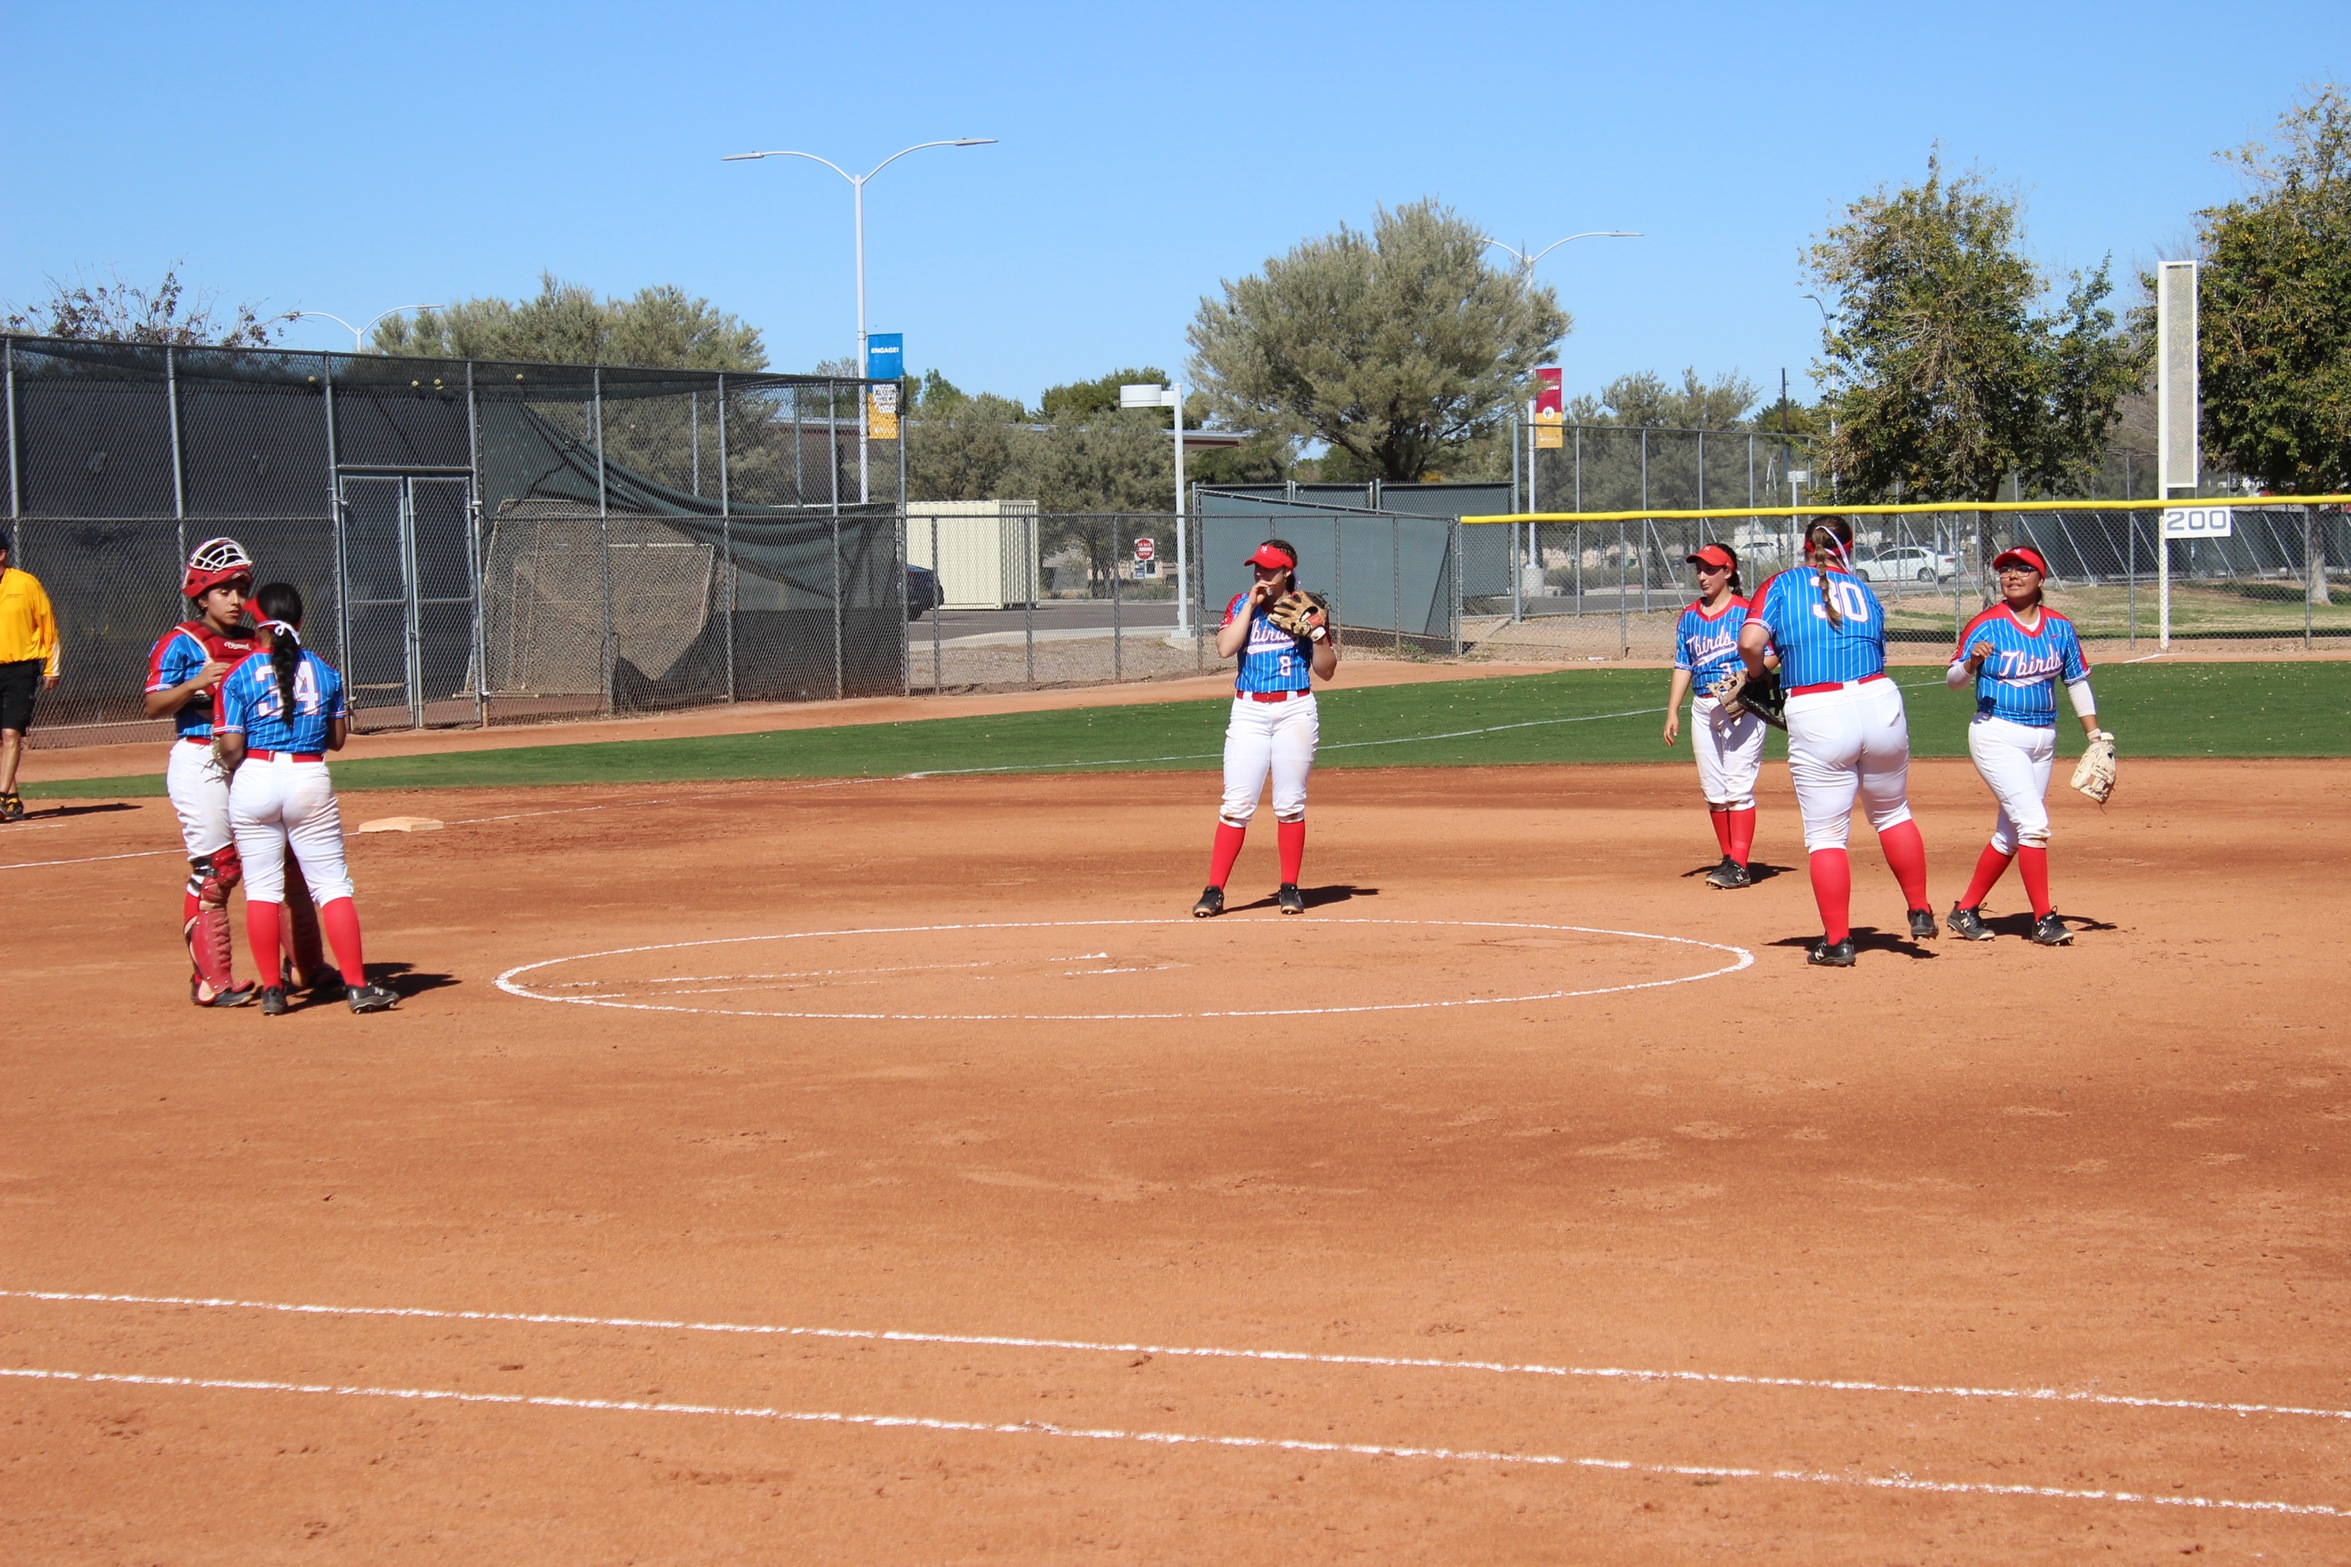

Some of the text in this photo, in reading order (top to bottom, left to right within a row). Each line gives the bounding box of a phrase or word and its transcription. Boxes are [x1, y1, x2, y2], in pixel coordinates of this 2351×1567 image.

[2166, 510, 2227, 531] 200
[1810, 576, 1869, 623] 30
[1685, 625, 1733, 657] Tbirds
[1279, 655, 1292, 677] 8
[1998, 643, 2063, 678] Tbirds
[254, 661, 320, 717] 34
